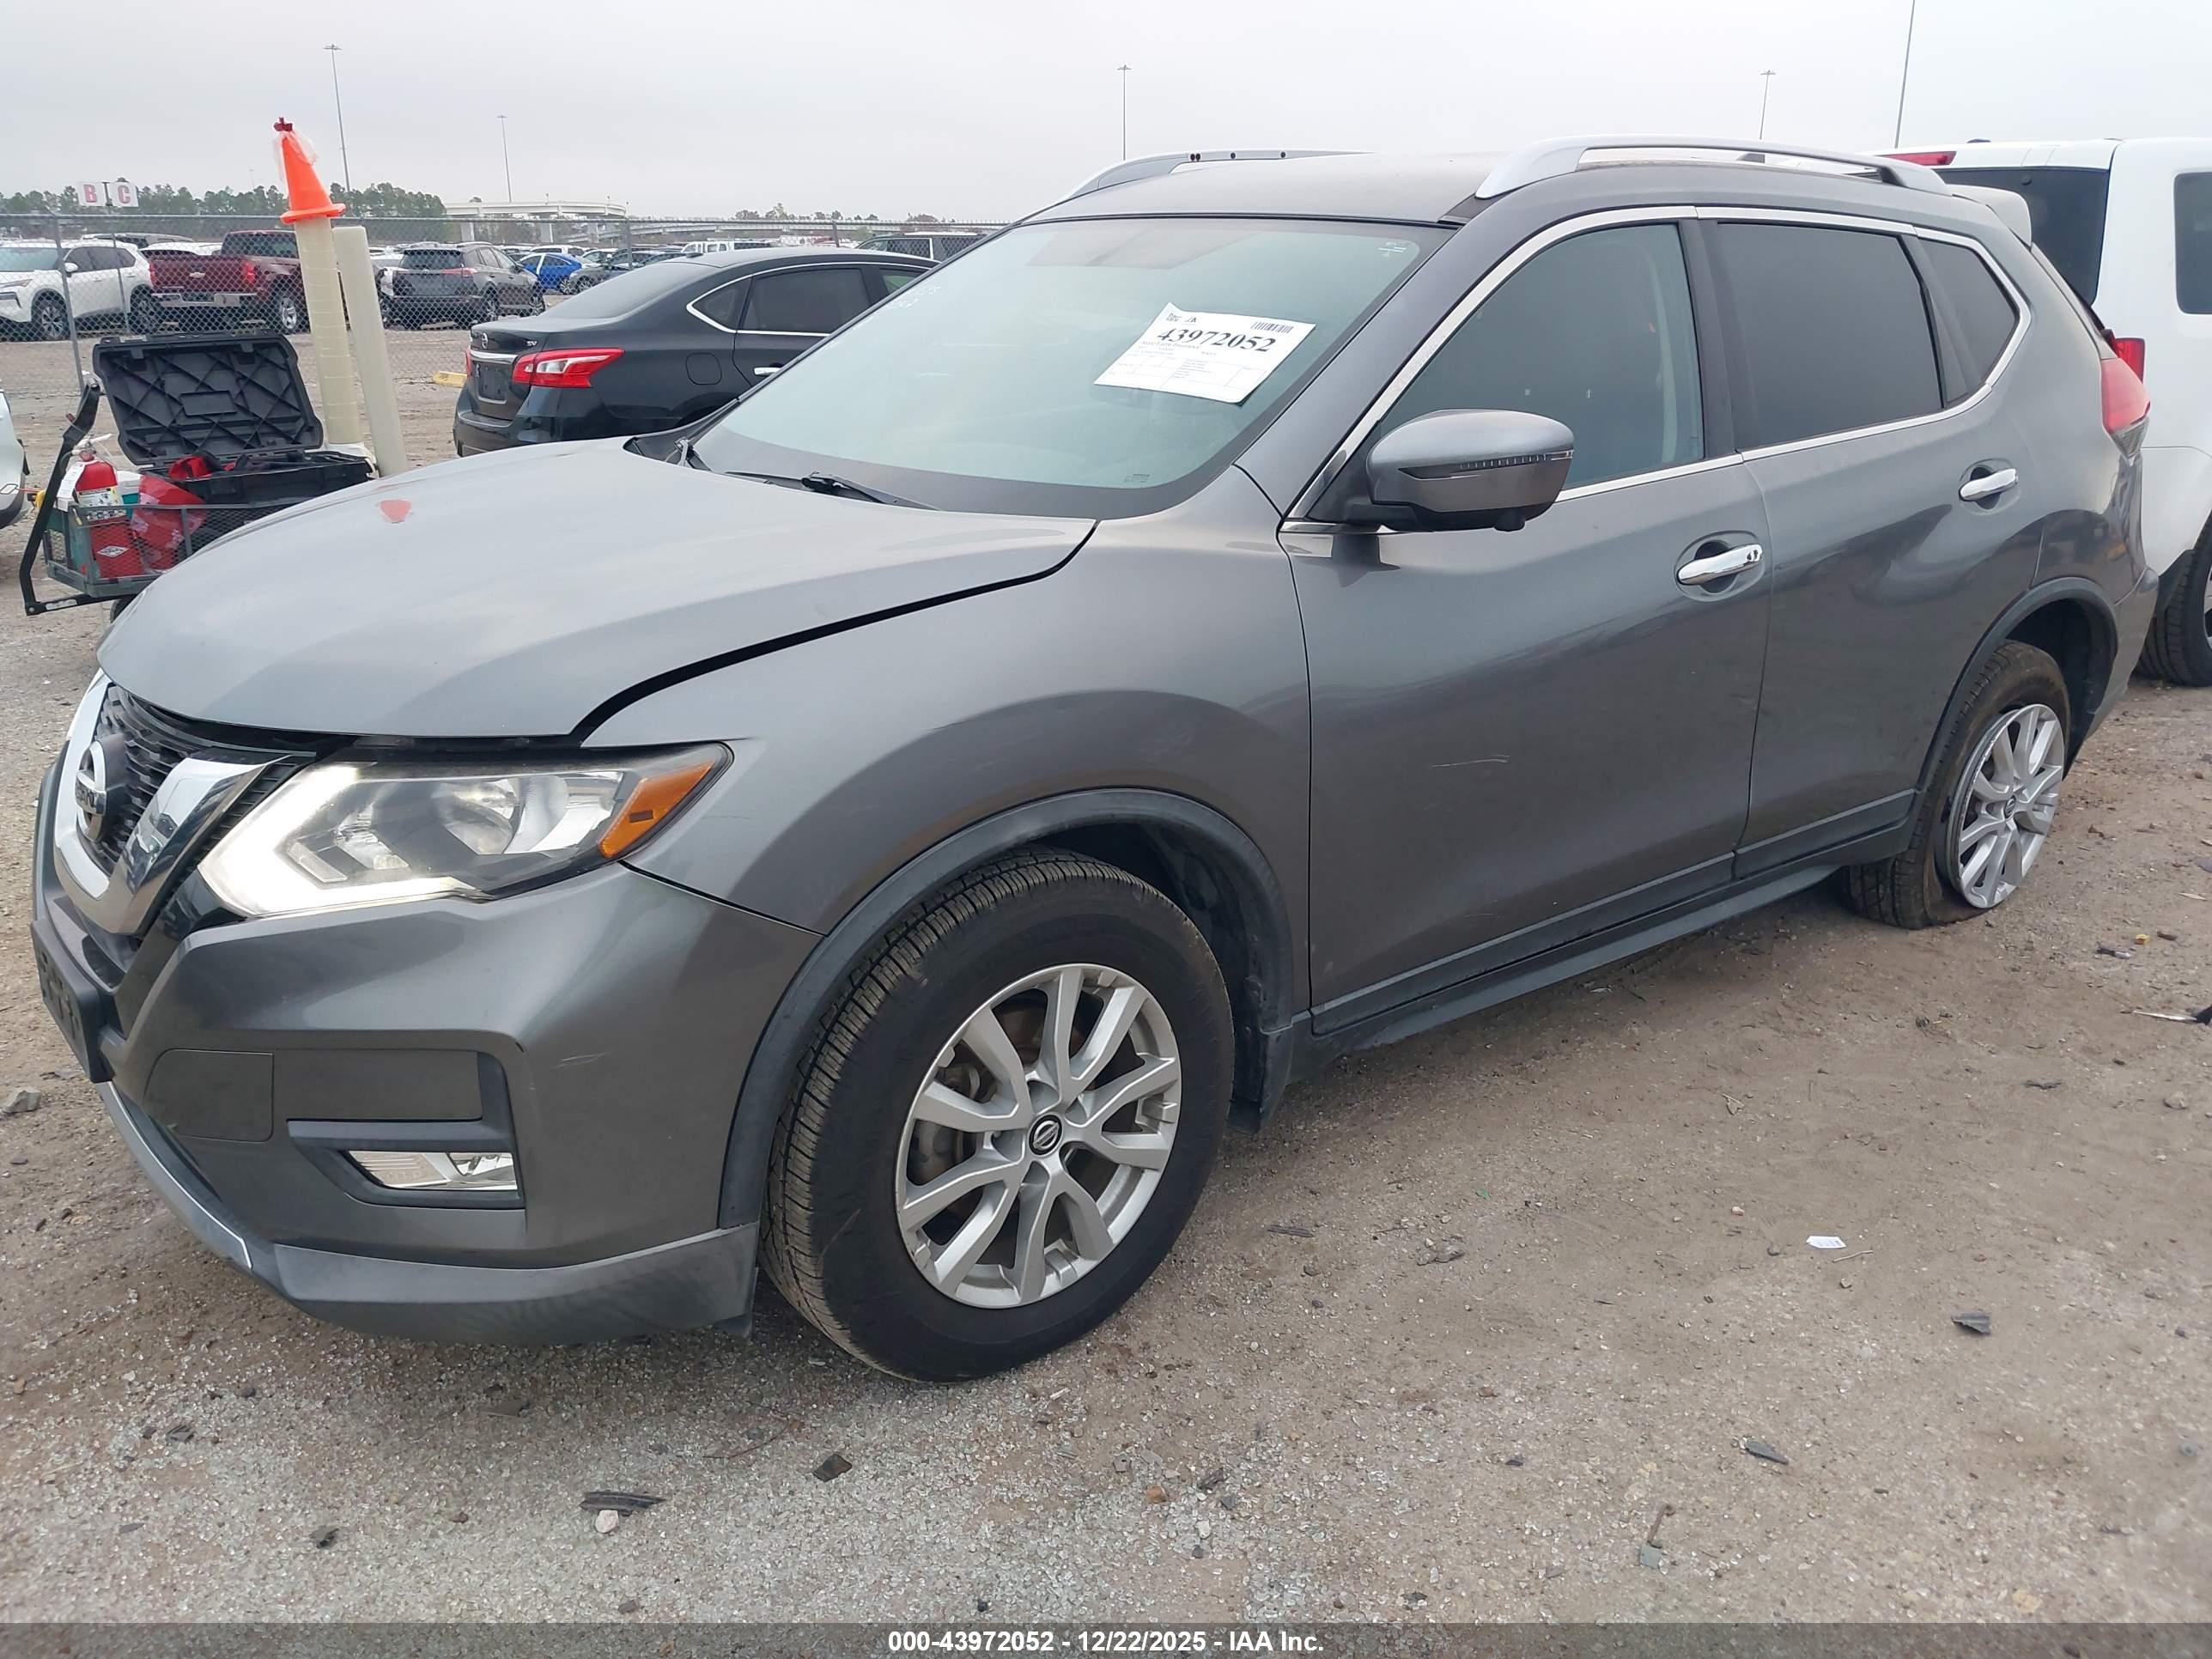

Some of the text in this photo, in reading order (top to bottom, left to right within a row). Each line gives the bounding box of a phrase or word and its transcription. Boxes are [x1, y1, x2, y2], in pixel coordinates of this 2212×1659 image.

[83, 184, 98, 204] B
[118, 185, 131, 204] C
[1157, 328, 1276, 352] 43972052
